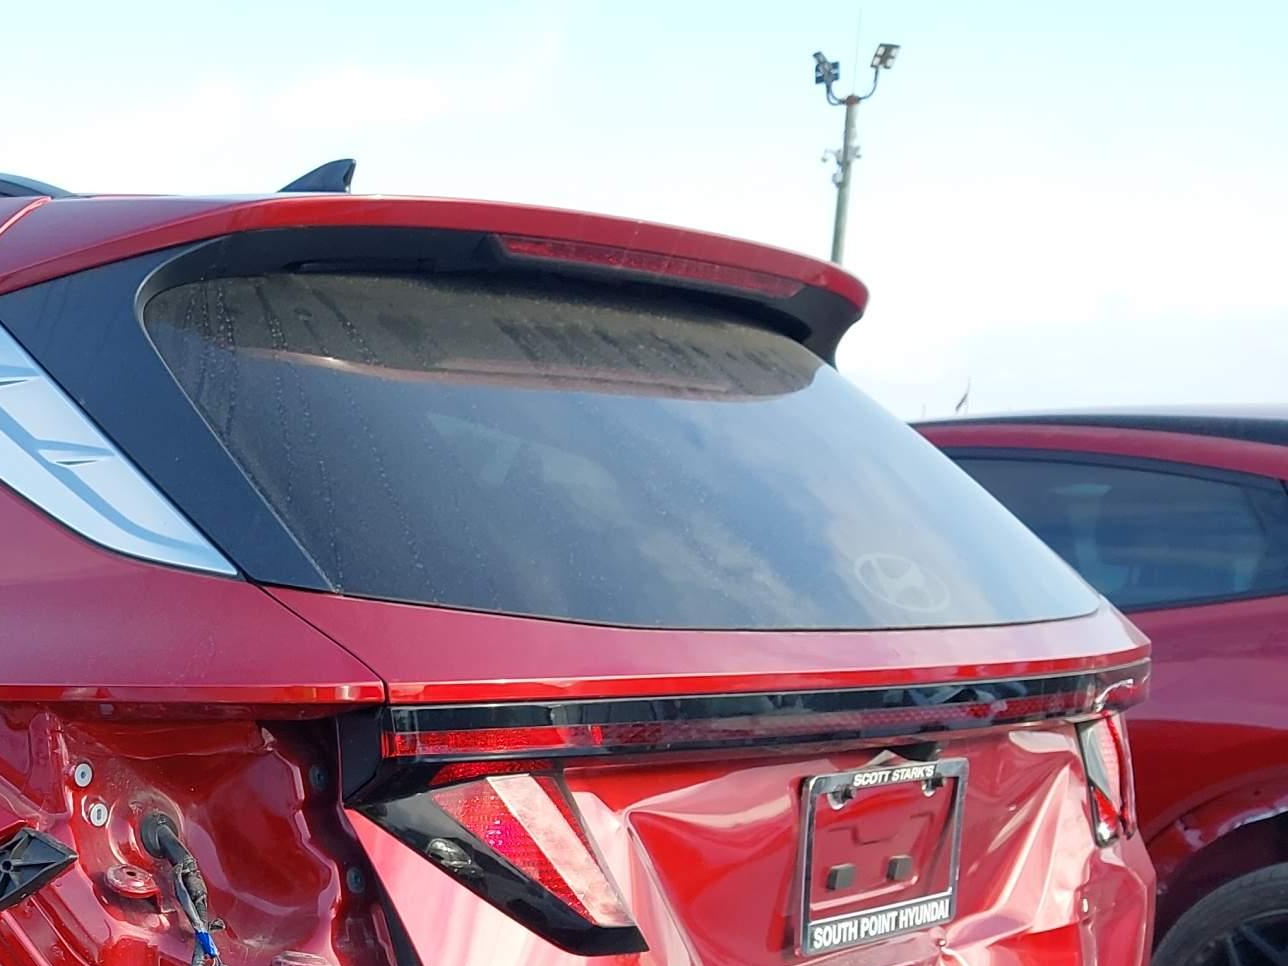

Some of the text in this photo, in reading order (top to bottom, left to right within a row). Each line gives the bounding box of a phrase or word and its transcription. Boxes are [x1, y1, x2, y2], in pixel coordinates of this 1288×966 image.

[853, 764, 935, 787] SCOTT STARK'S
[813, 898, 951, 949] SOUTH POINT HYUNDAI
